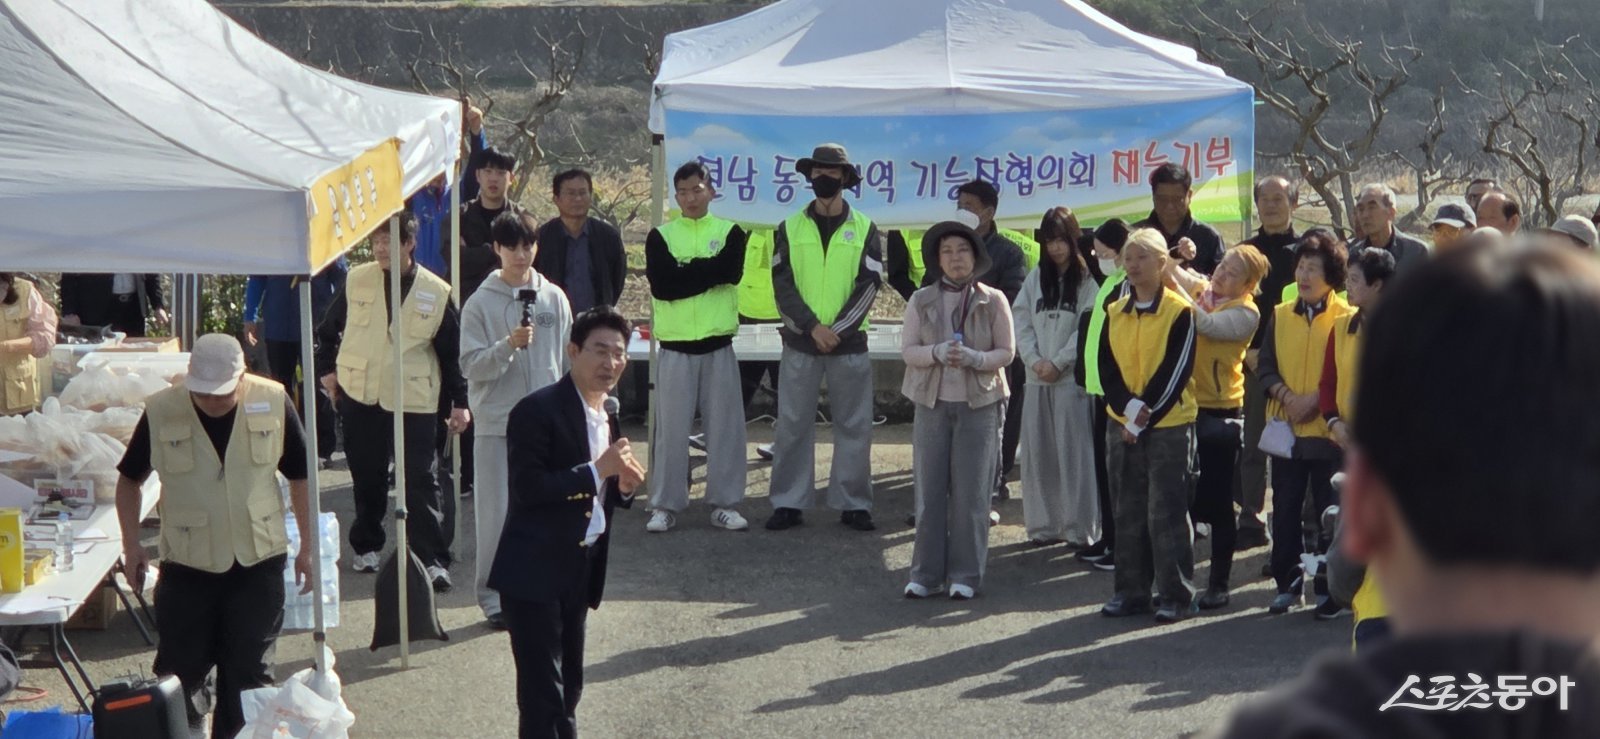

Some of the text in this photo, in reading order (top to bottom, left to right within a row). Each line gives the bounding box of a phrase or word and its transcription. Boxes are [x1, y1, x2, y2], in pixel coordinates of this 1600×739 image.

[772, 155, 895, 203] 동역
[911, 151, 1095, 200] 기능장협의회
[1112, 136, 1232, 184] 재능기부
